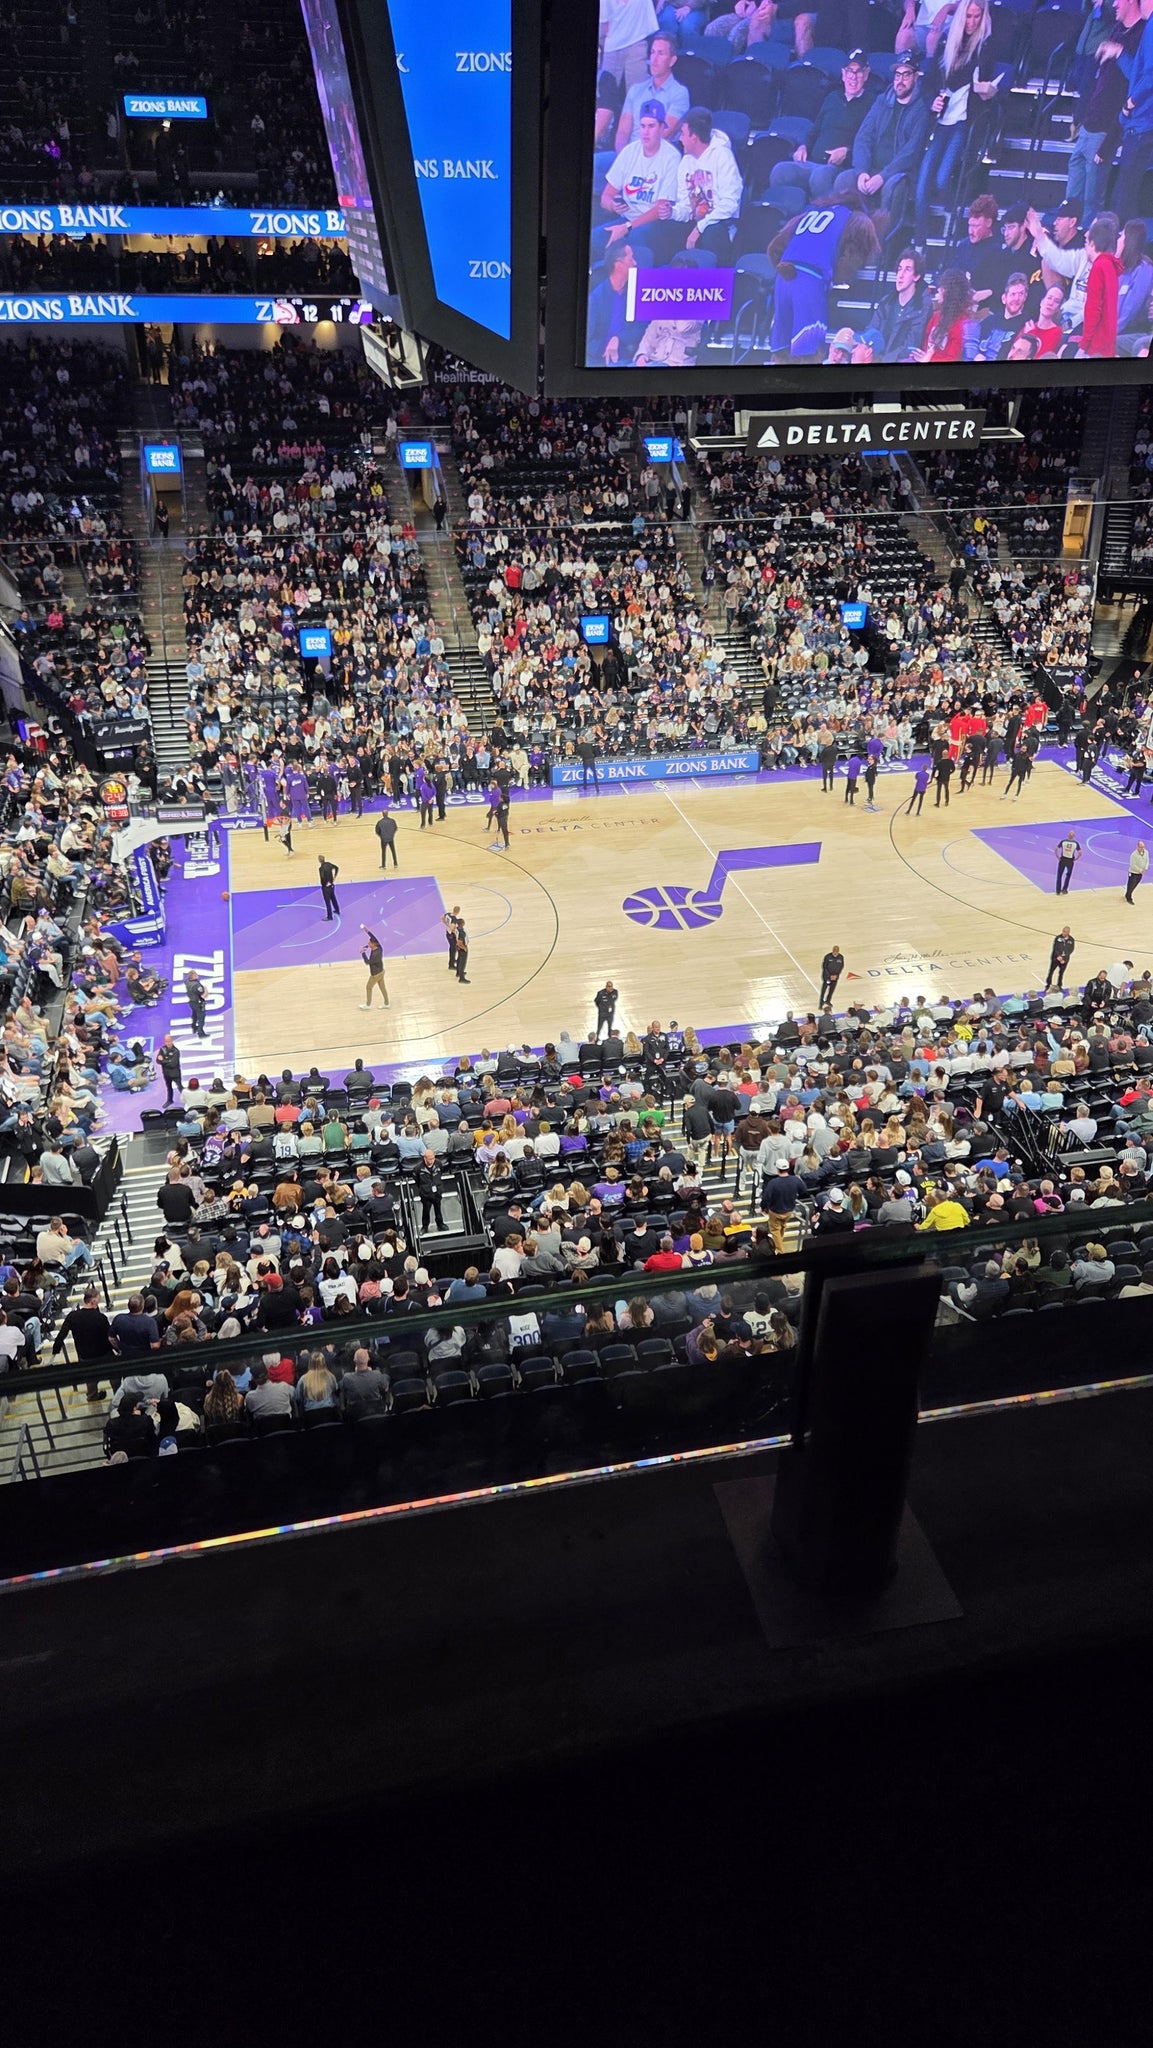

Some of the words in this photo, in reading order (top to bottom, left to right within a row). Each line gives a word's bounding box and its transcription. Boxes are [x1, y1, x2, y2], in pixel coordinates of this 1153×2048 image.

[130, 101, 166, 113] ZIONS
[167, 100, 201, 113] BANK
[443, 160, 496, 179] BANK
[58, 205, 128, 228] BANK
[250, 213, 321, 235] ZIONS
[795, 210, 835, 235] 00
[641, 288, 684, 302] ZIONS
[686, 288, 724, 302] BANK
[67, 295, 137, 317] BANK
[302, 304, 318, 323] 12
[330, 304, 343, 322] 11
[787, 424, 872, 445] DELTA
[882, 420, 976, 442] CENTER
[405, 455, 428, 463] BANK
[608, 765, 646, 779] BANK
[665, 761, 707, 775] ZIONS
[711, 757, 748, 771] BANK
[520, 824, 584, 835] DELTA
[591, 818, 661, 830] CENTER
[867, 963, 943, 978] DELTA
[949, 953, 1033, 969] CENTER
[280, 1145, 292, 1157] 19
